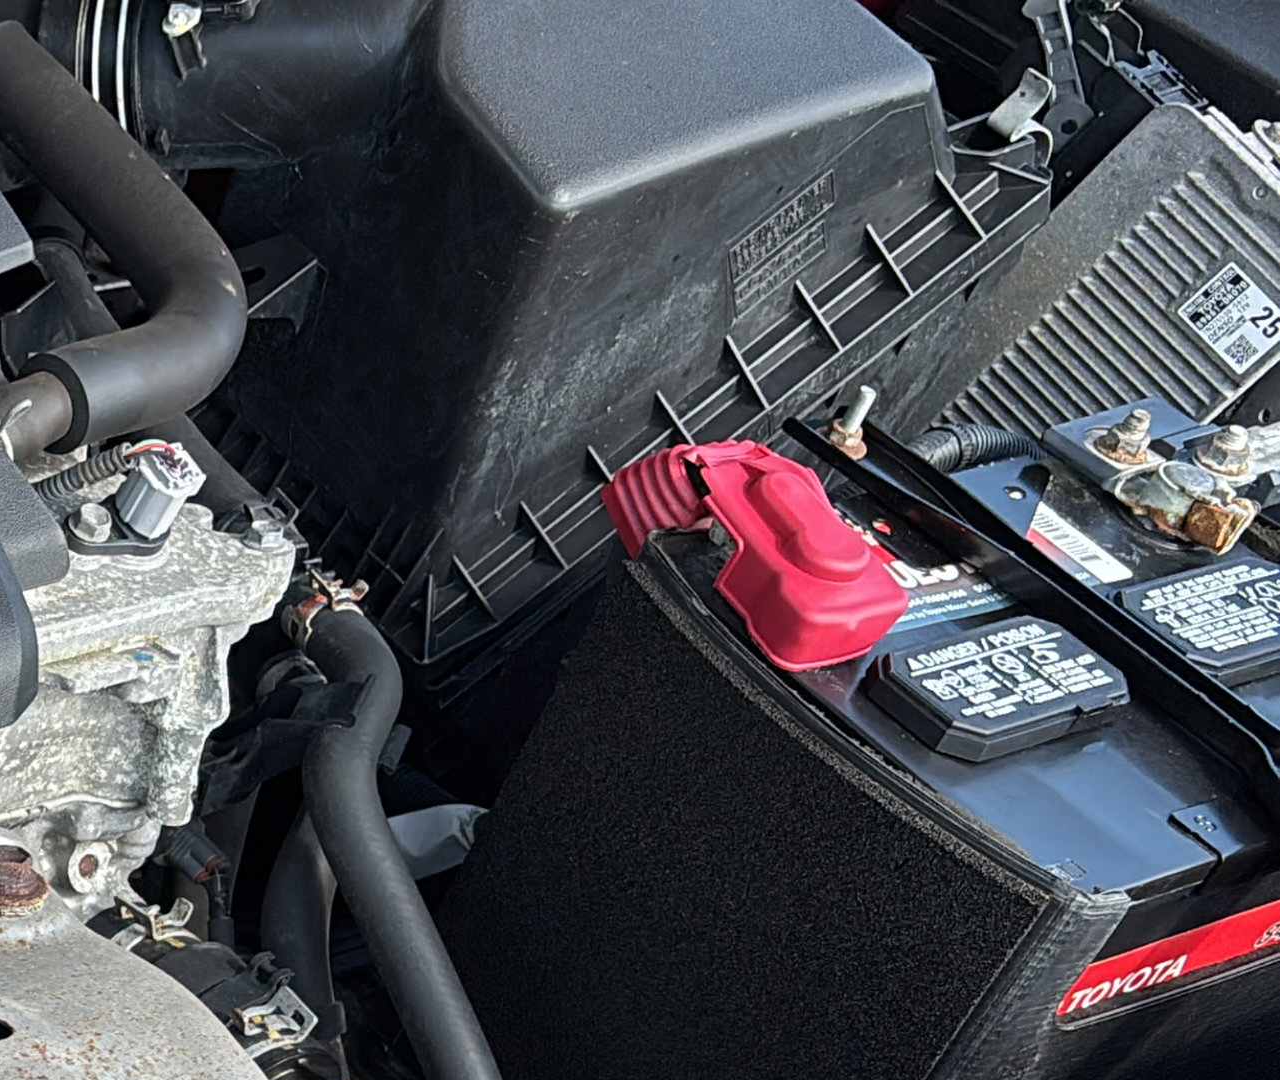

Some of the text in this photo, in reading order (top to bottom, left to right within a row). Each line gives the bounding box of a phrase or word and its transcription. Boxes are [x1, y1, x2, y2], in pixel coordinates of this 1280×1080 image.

[1197, 283, 1234, 314] TOYOTA
[1208, 316, 1234, 341] DENSO
[1249, 306, 1280, 338] 25
[916, 640, 982, 668] DANGER
[988, 623, 1046, 649] POISON
[1066, 954, 1189, 1014] TOYOTA
